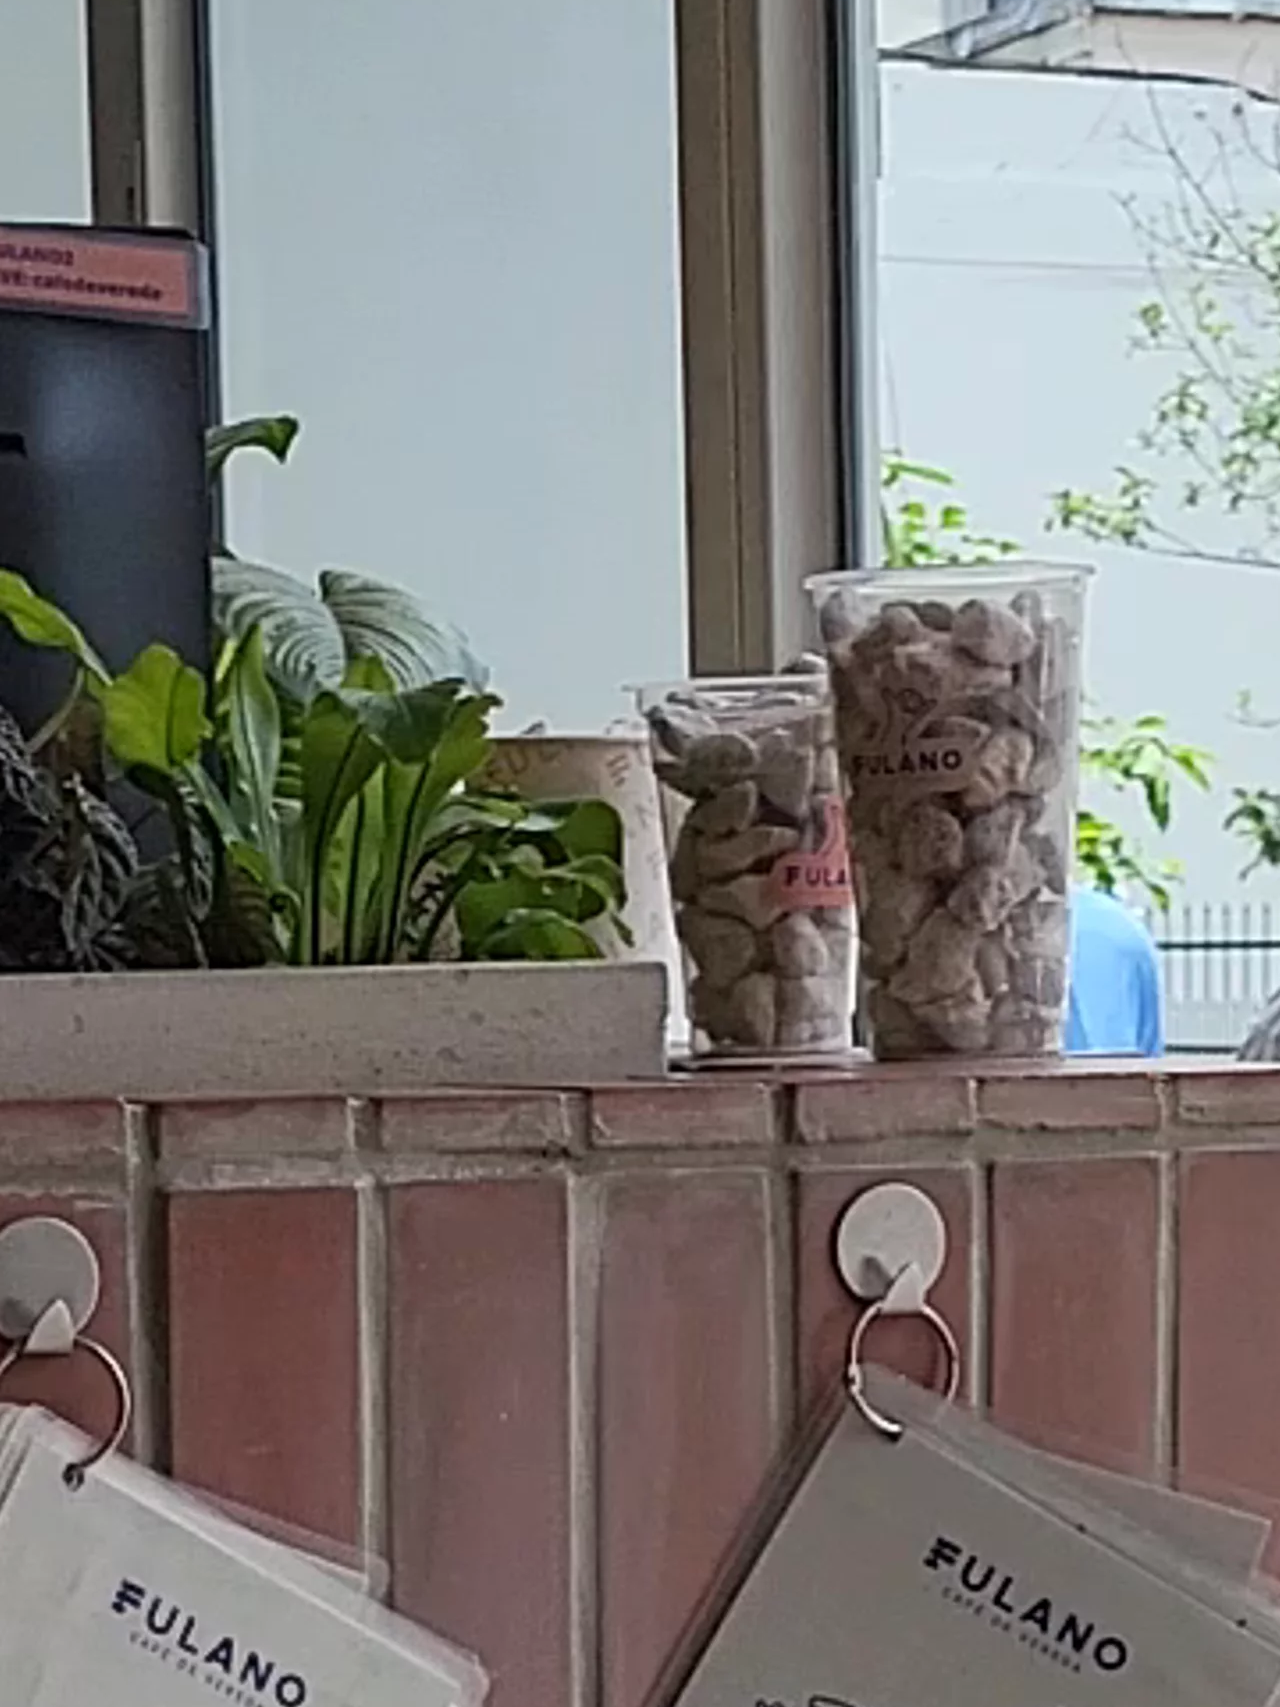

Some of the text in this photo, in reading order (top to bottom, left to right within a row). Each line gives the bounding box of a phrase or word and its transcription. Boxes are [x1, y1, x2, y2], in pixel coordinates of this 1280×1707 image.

[851, 748, 963, 776] FULANO
[112, 1580, 305, 1707] FULANO
[924, 1537, 1126, 1670] FULANO
